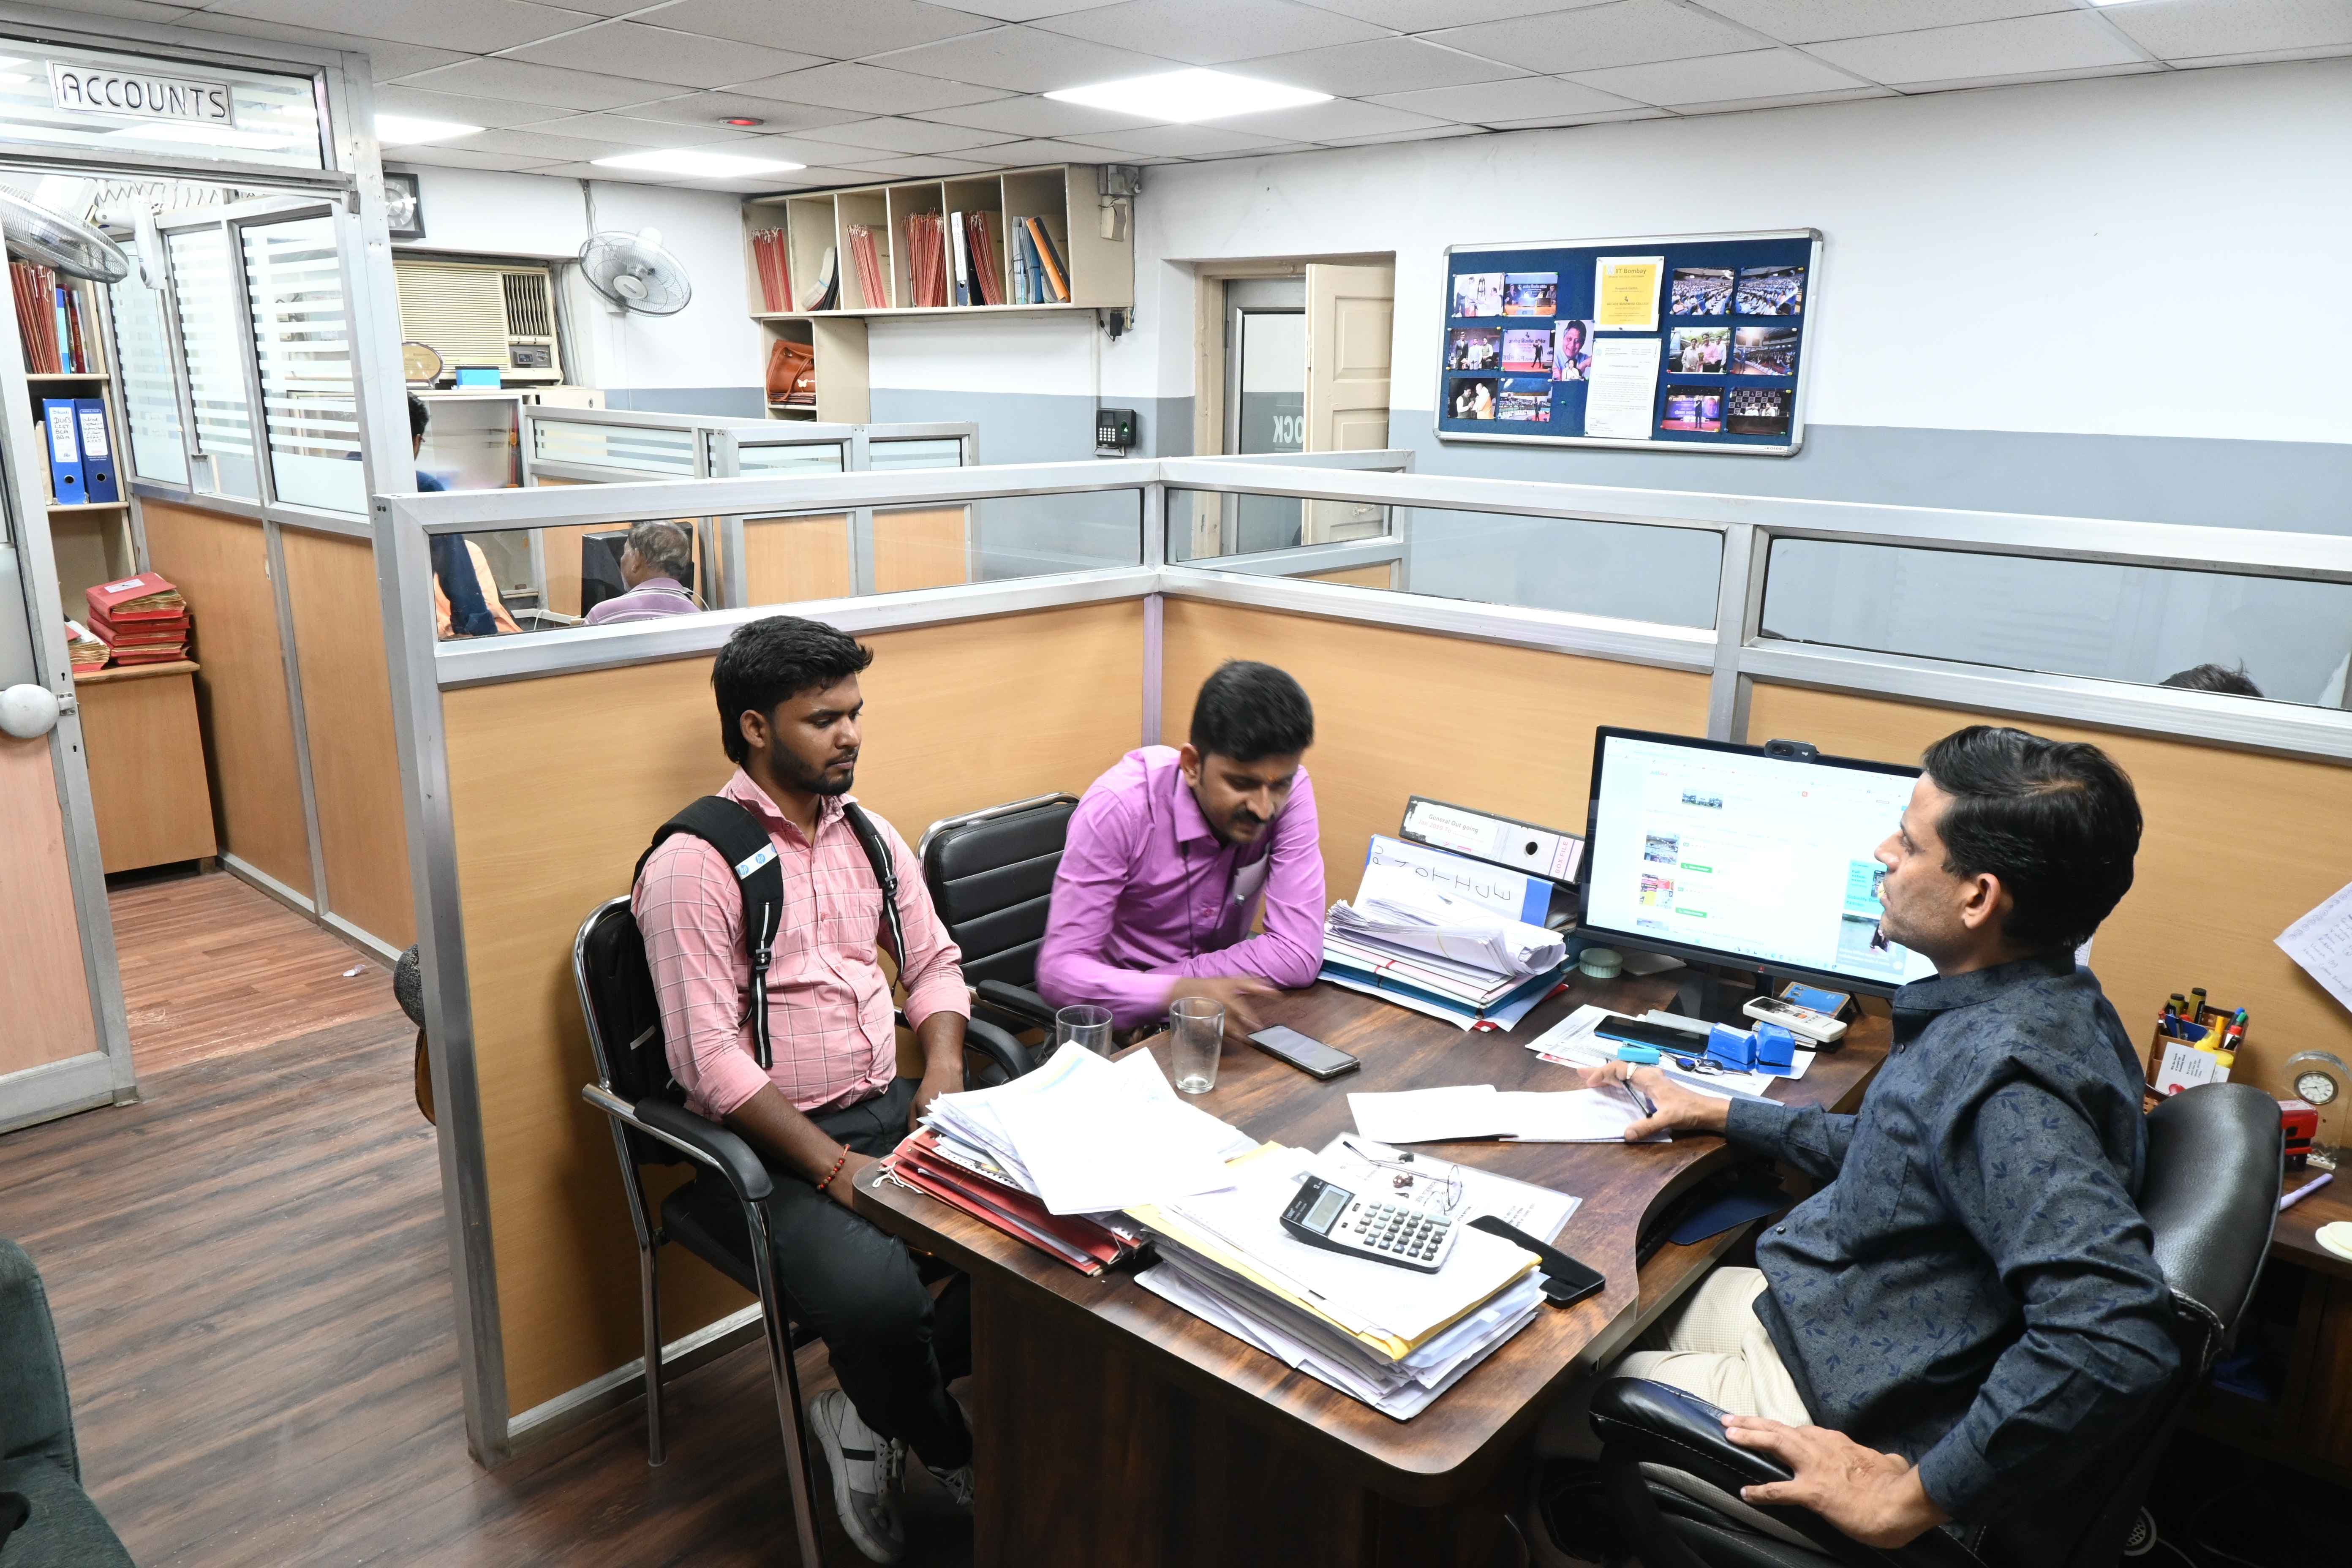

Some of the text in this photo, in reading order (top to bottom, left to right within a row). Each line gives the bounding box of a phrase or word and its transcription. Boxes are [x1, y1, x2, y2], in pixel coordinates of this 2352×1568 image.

[61, 73, 226, 119] ACCOUNTS
[1429, 814, 1451, 825] General
[1462, 825, 1479, 833] going
[1429, 822, 1443, 830] 2019
[756, 854, 765, 864] hp
[1555, 841, 1568, 874] BOX FILE
[739, 865, 748, 875] hp
